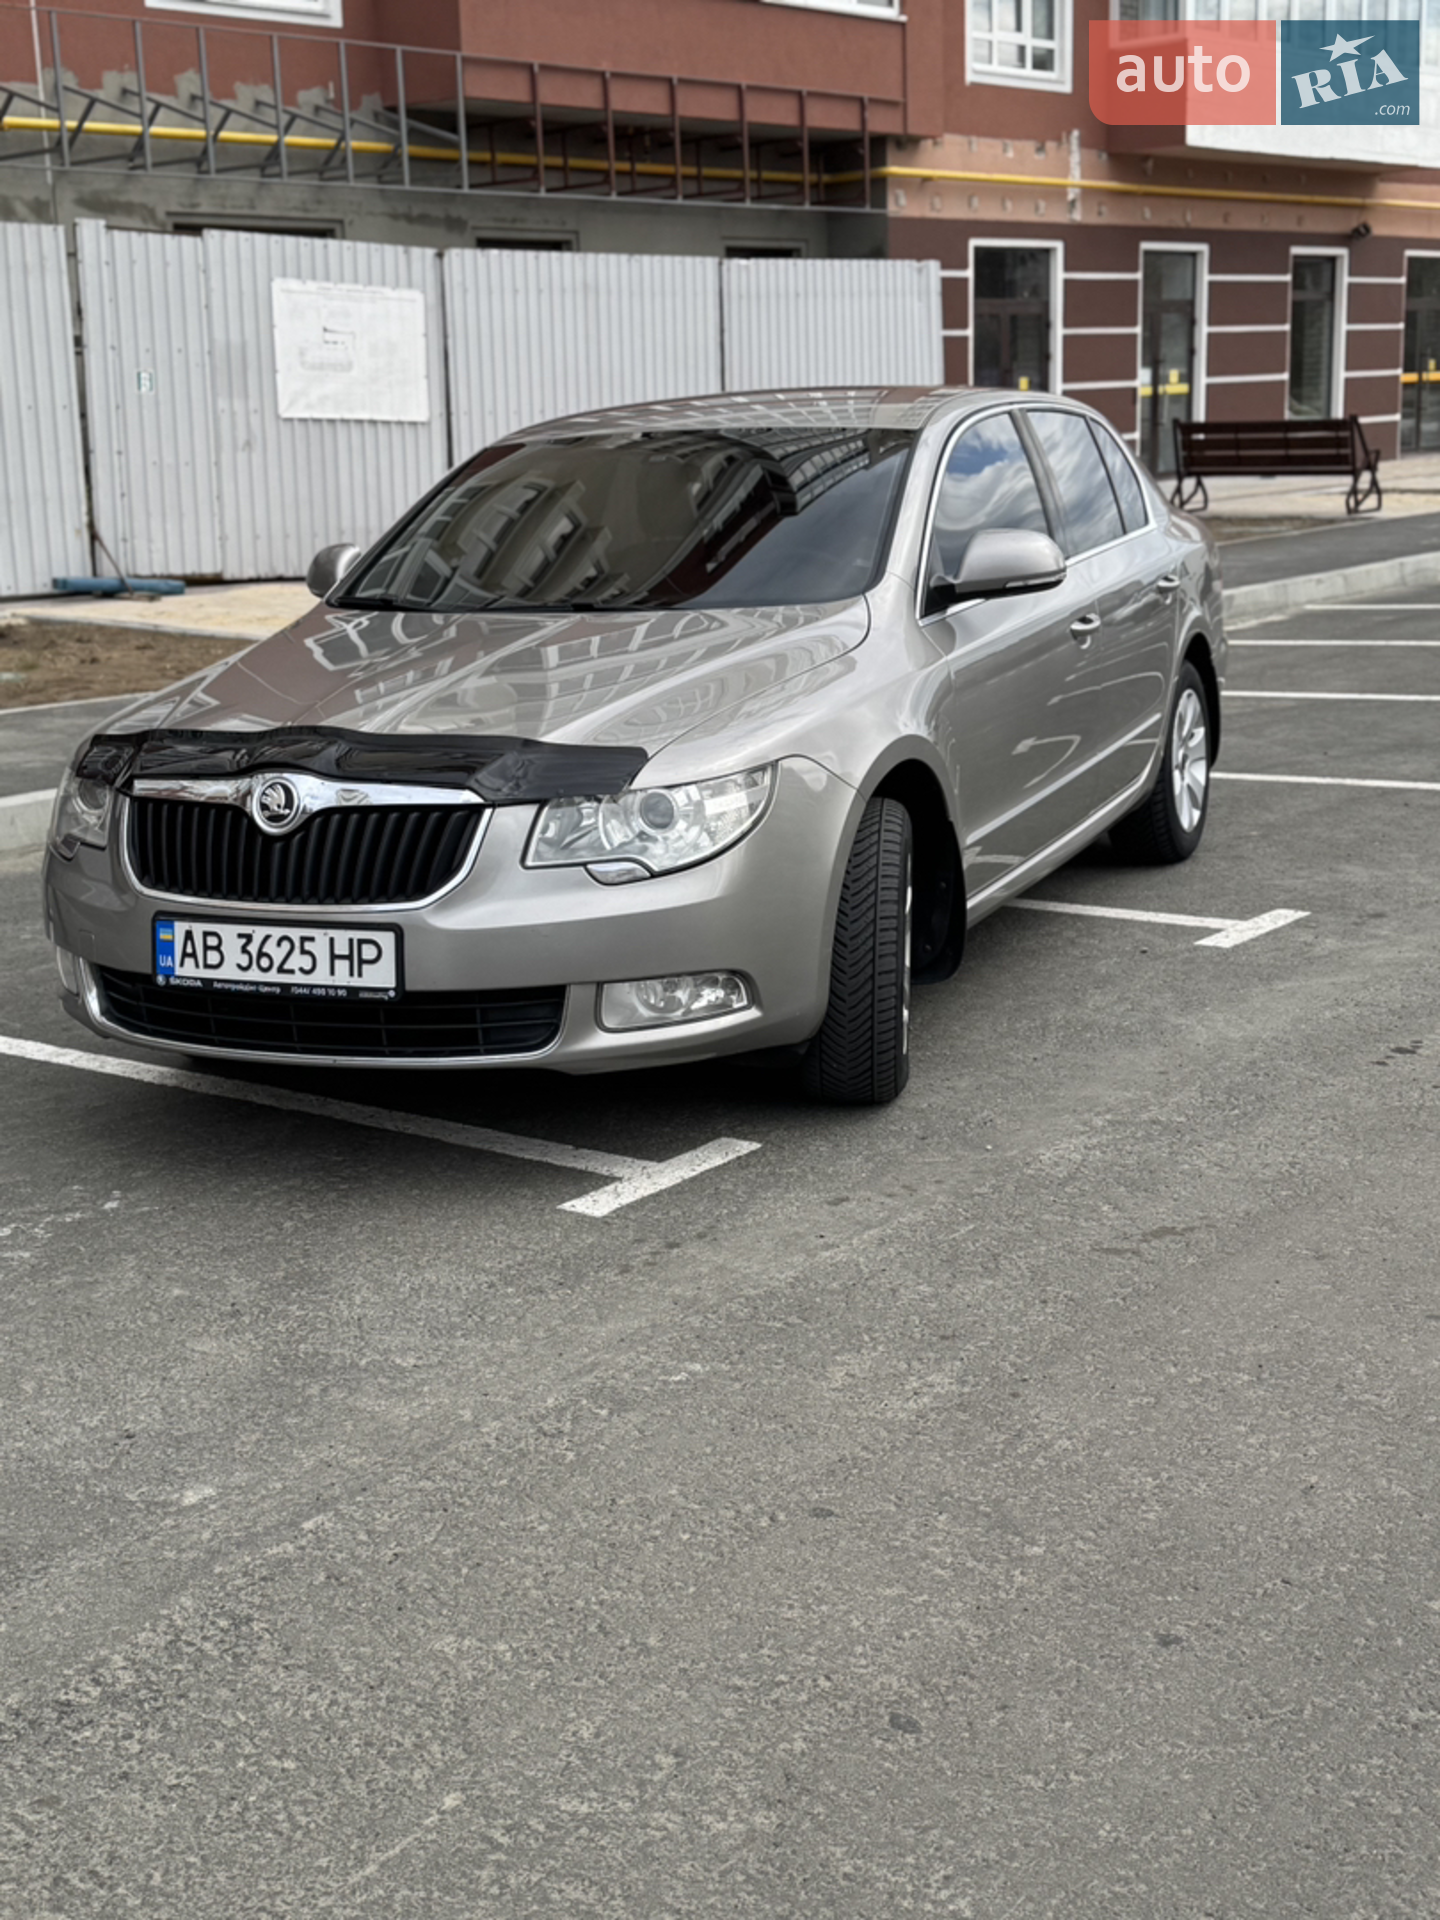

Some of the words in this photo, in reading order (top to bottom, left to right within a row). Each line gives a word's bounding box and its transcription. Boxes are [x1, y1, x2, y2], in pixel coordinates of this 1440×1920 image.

[159, 955, 174, 968] UA
[179, 929, 225, 970] AB
[236, 933, 317, 975] 3625
[329, 936, 383, 979] HP
